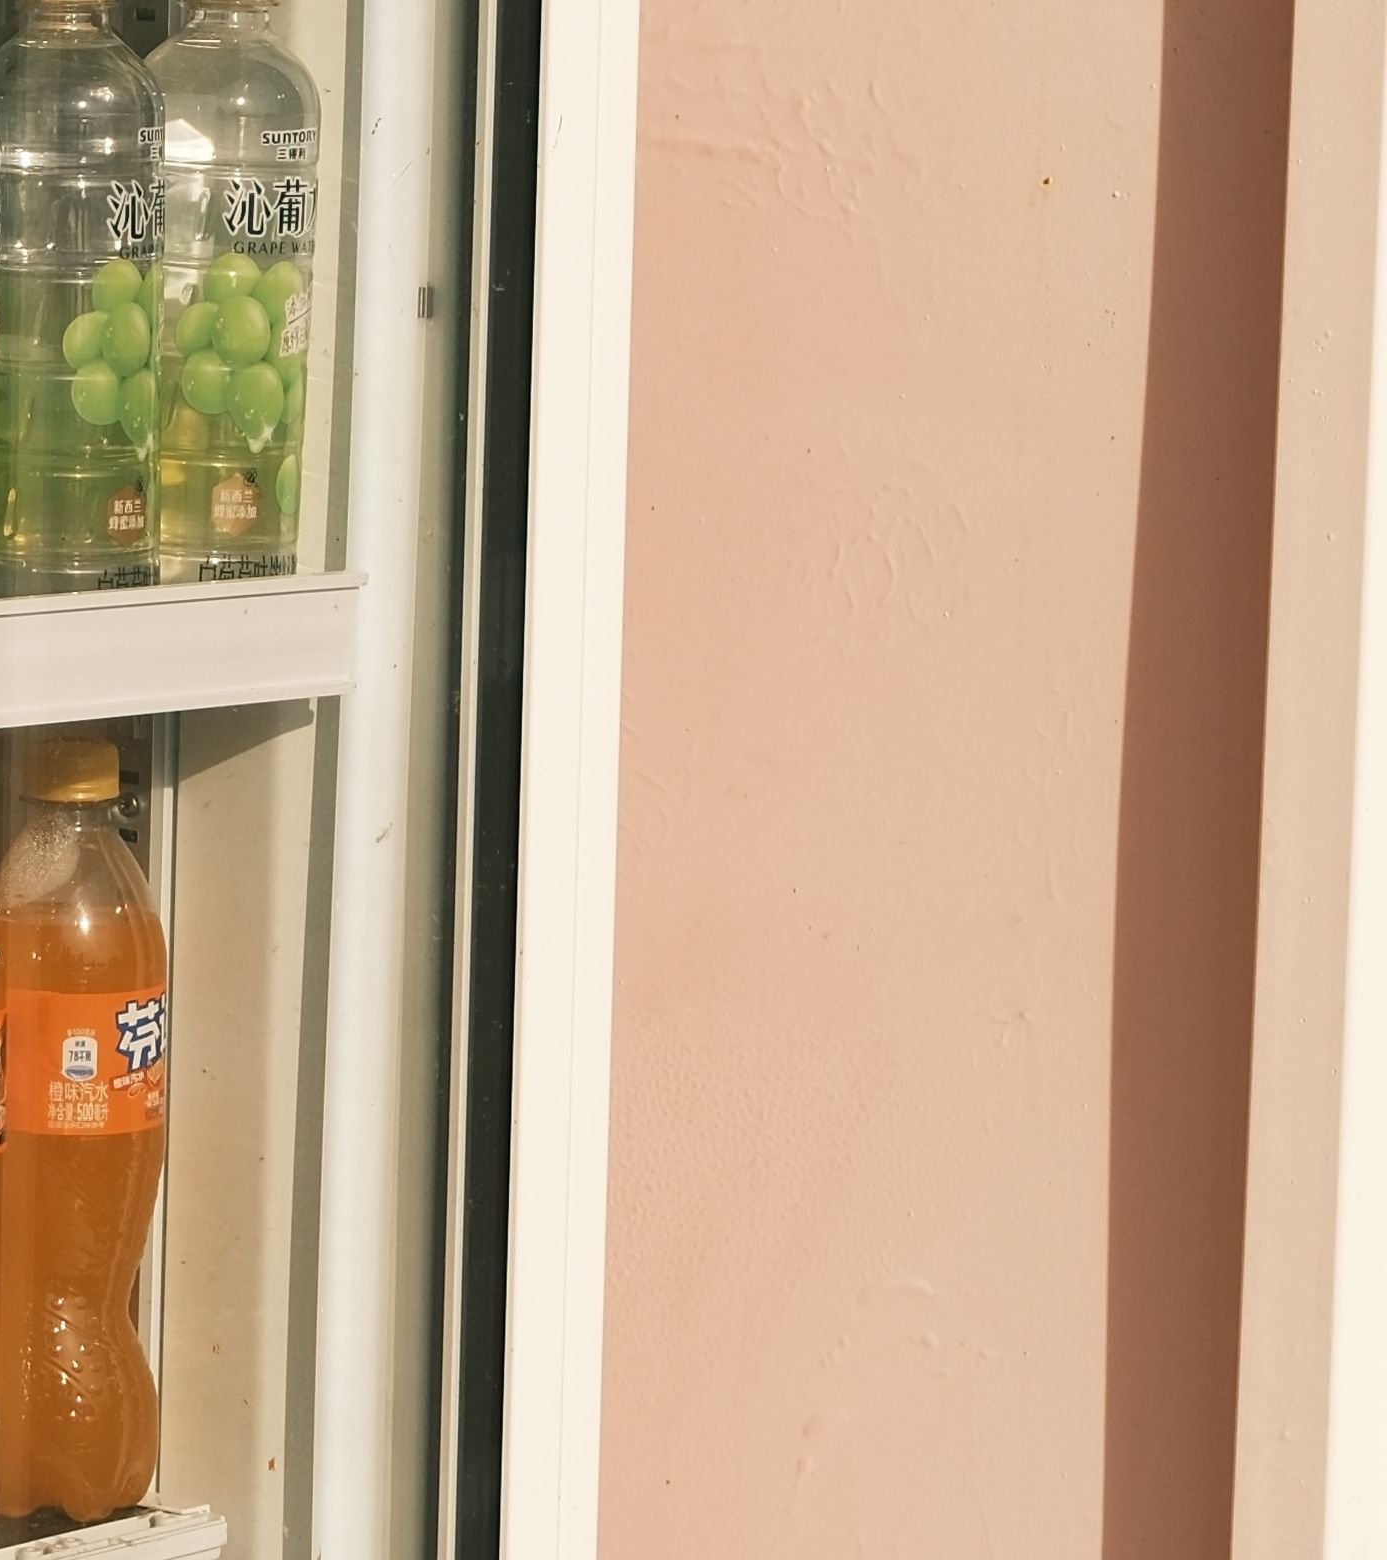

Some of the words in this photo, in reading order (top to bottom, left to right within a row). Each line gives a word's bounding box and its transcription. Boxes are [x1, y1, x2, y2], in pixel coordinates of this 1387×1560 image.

[276, 146, 307, 161] 三得利
[233, 240, 289, 256] GRAPE
[48, 1082, 109, 1101] 橙味汽水
